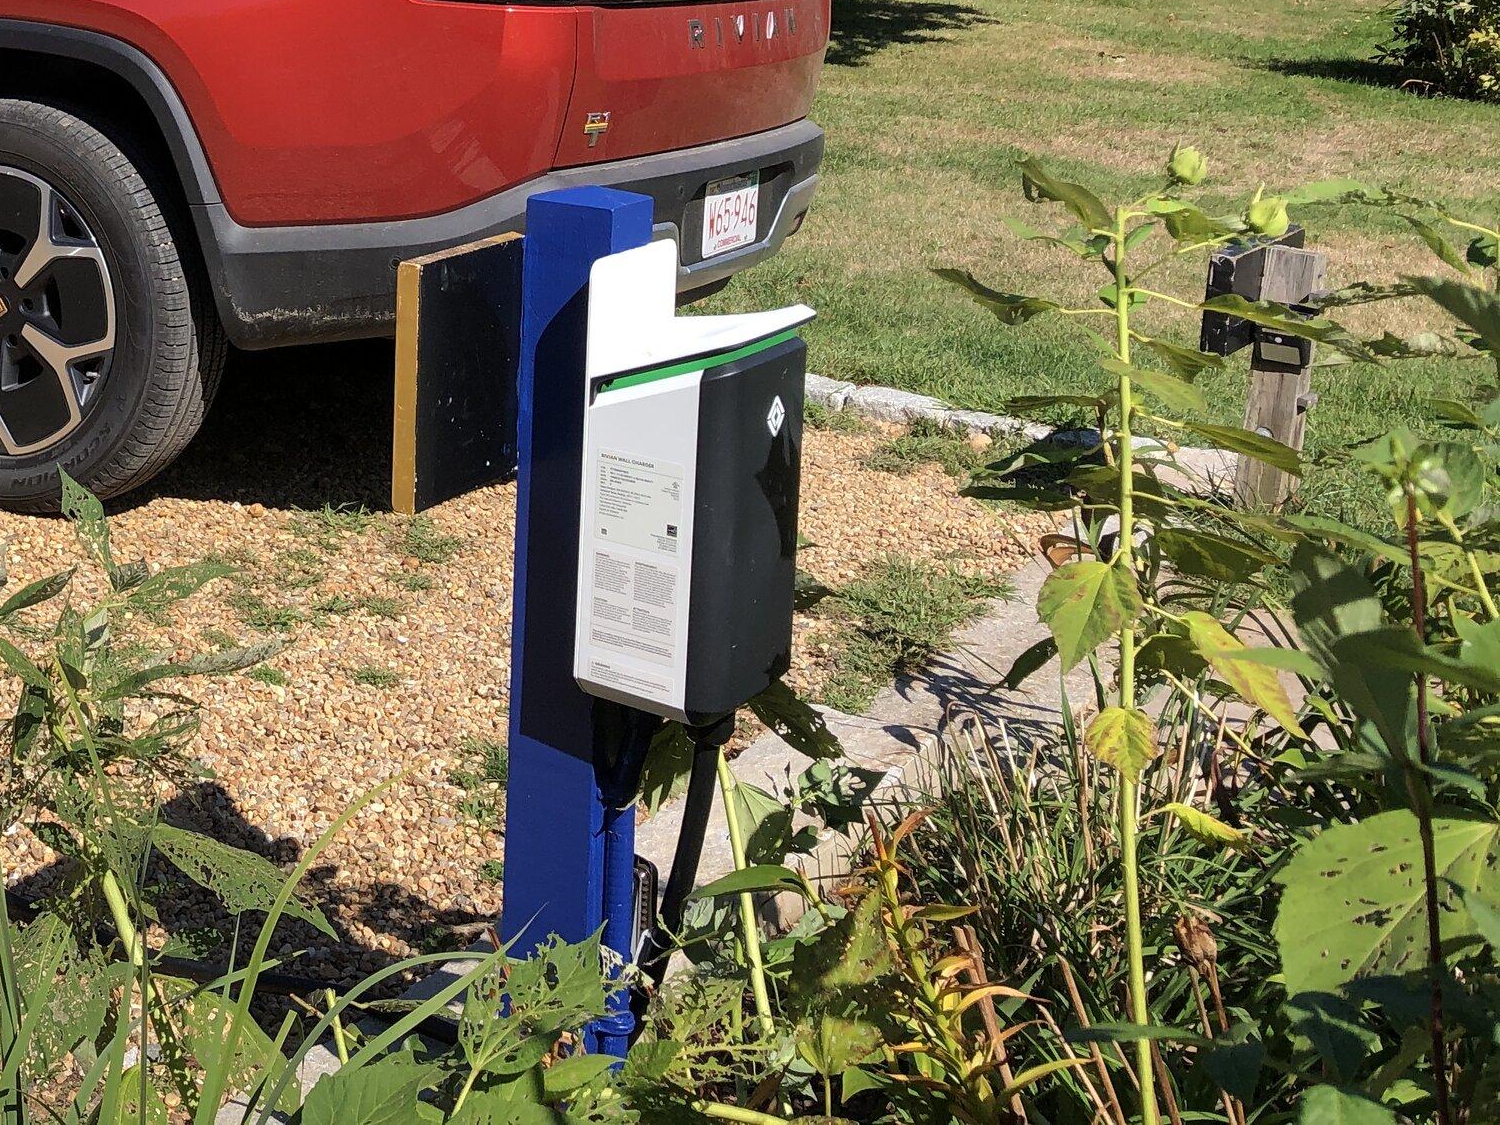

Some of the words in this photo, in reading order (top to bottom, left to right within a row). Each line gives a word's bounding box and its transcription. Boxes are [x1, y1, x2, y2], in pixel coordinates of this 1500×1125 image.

[687, 7, 797, 49] RIVIAN
[618, 456, 631, 464] WALL
[632, 460, 654, 468] CHARGER
